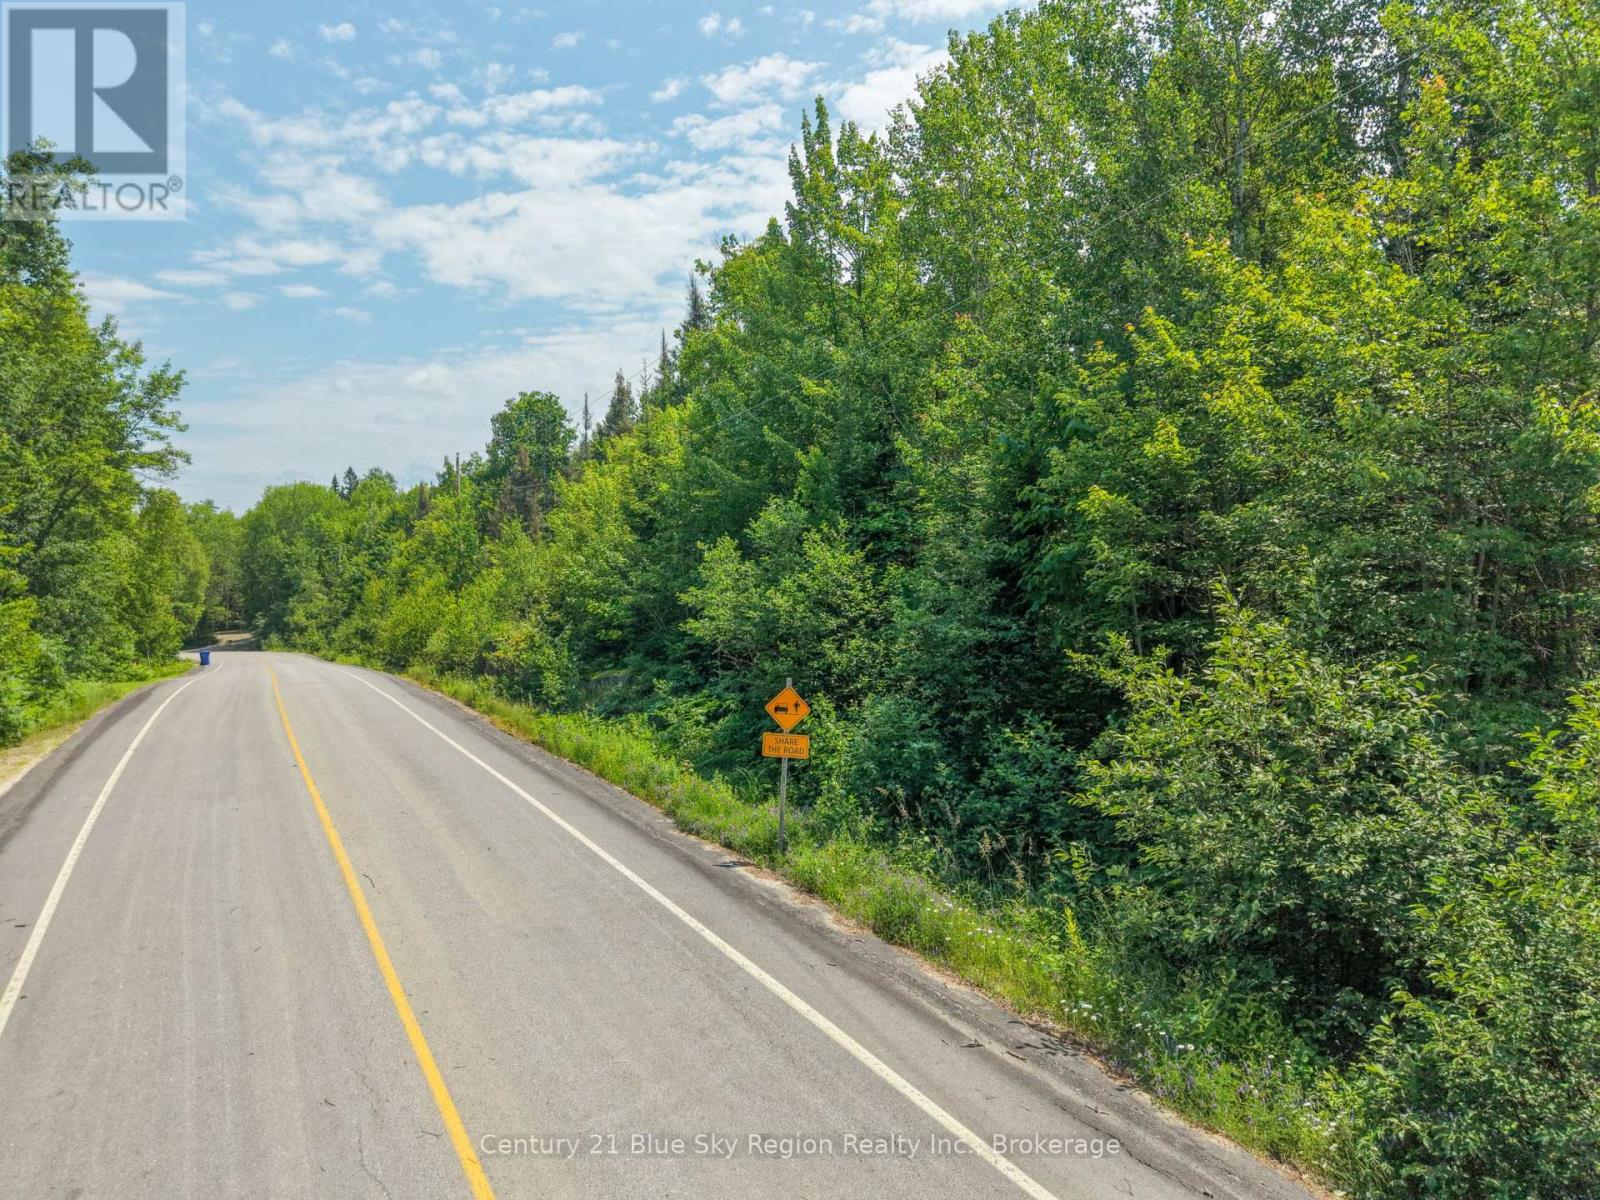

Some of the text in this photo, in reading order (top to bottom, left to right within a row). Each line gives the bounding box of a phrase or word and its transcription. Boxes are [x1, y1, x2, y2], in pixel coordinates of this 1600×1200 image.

[774, 737, 799, 745] SHARE
[768, 745, 804, 754] THE ROAD
